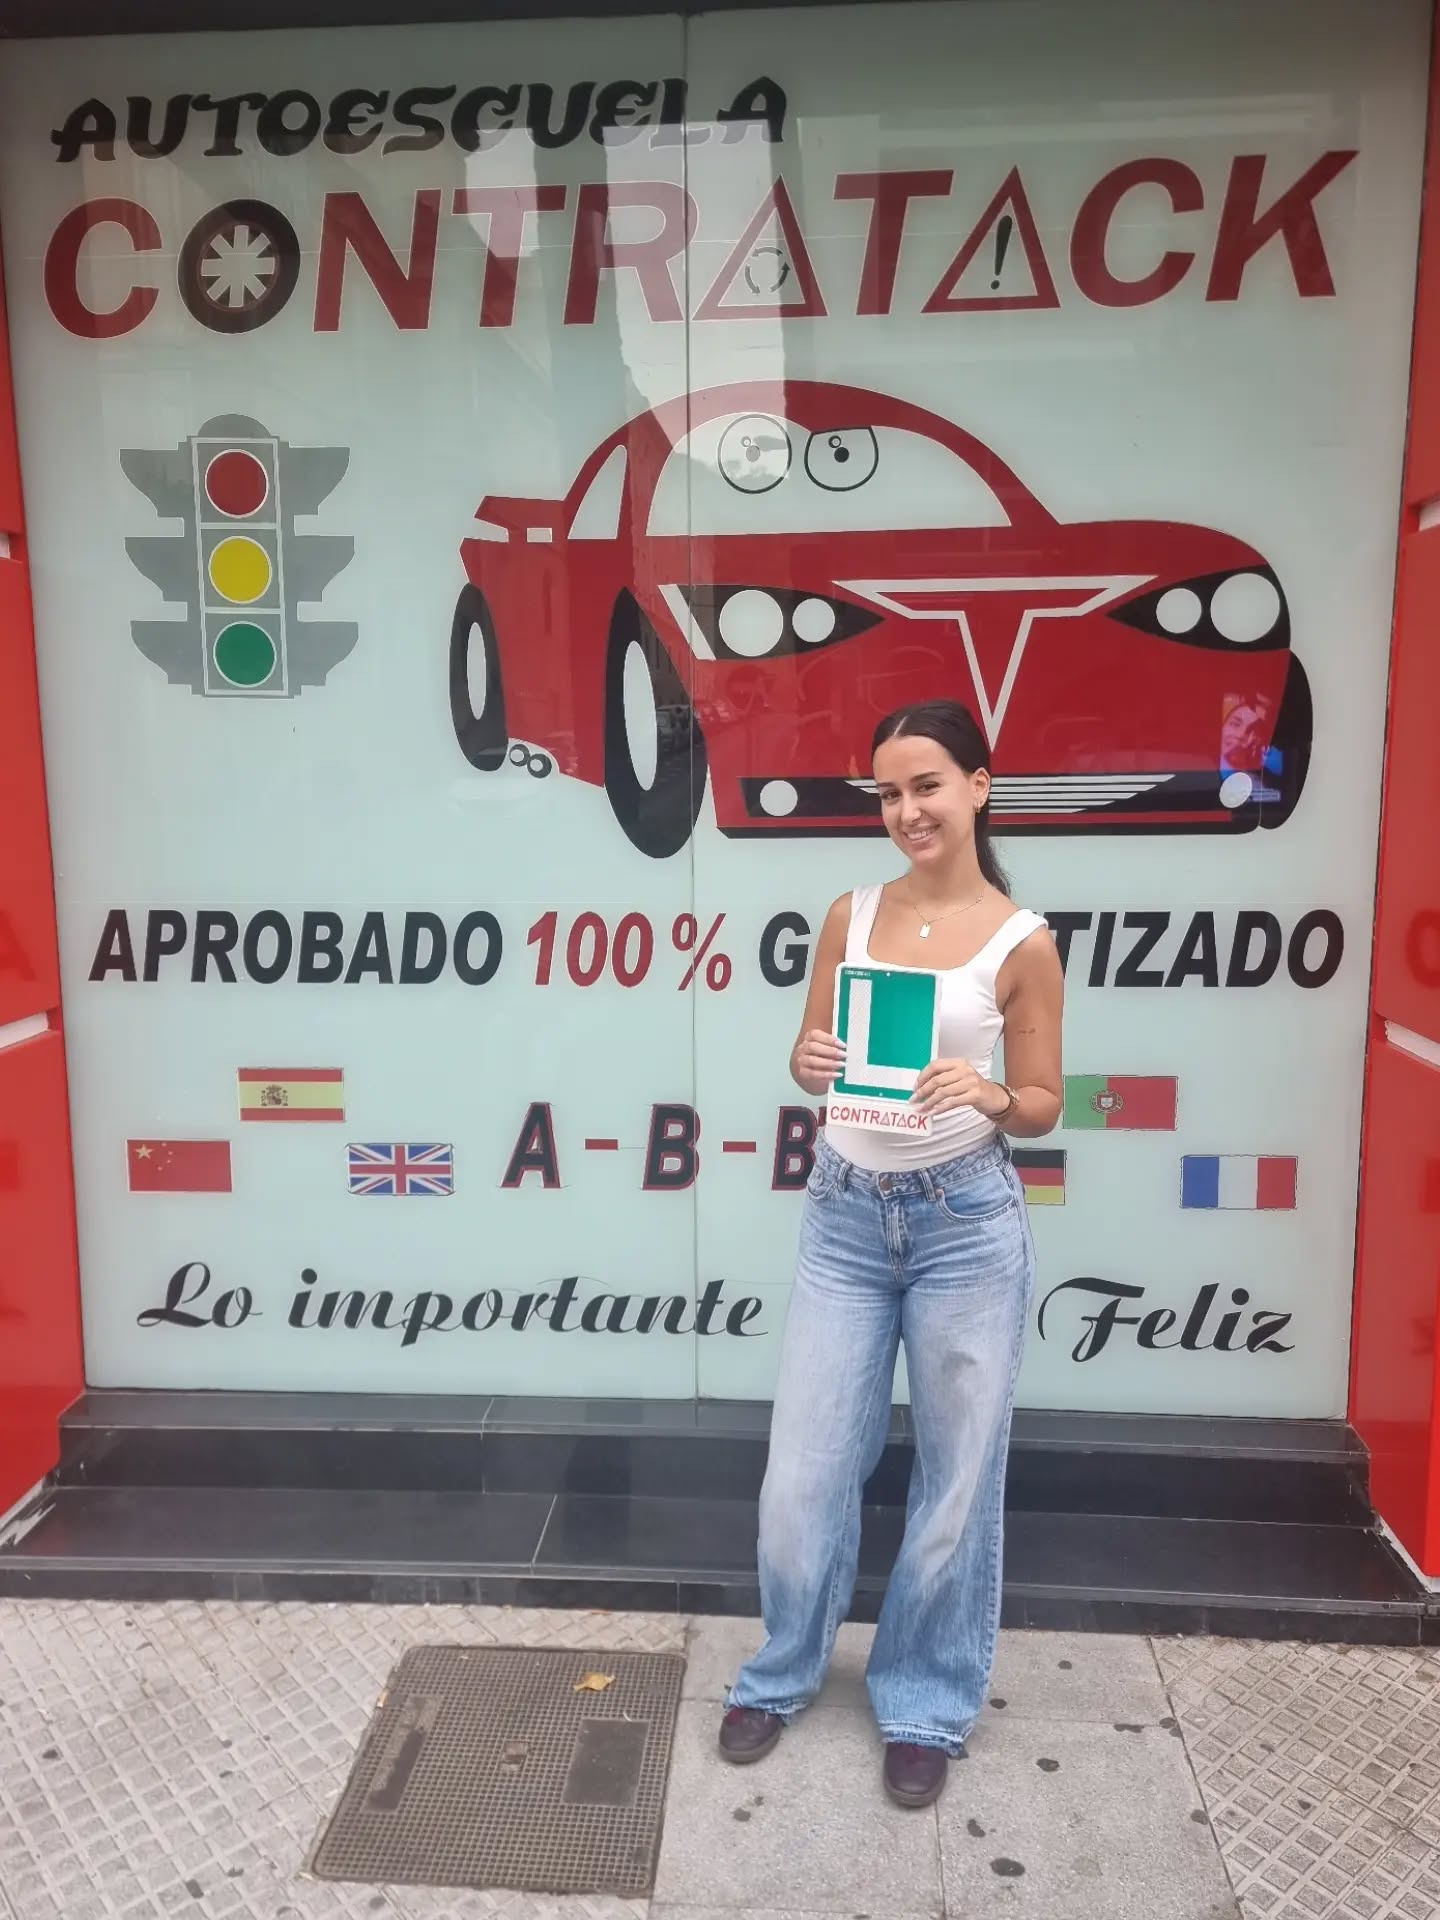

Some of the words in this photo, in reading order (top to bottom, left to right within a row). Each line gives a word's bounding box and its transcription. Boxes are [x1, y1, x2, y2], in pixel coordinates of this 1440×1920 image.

[50, 76, 788, 162] AUTOESCUELA
[43, 149, 1361, 340] CONTRATACK
[89, 909, 504, 986] APROBADO
[758, 909, 1345, 989] GTIZADO
[844, 977, 921, 1092] L
[500, 1101, 562, 1189] A
[642, 1103, 702, 1191] B
[830, 1105, 929, 1131] CONTRATACK
[136, 1261, 264, 1329] Lo
[288, 1267, 769, 1348] importante
[1037, 1276, 1296, 1363] Feliz
